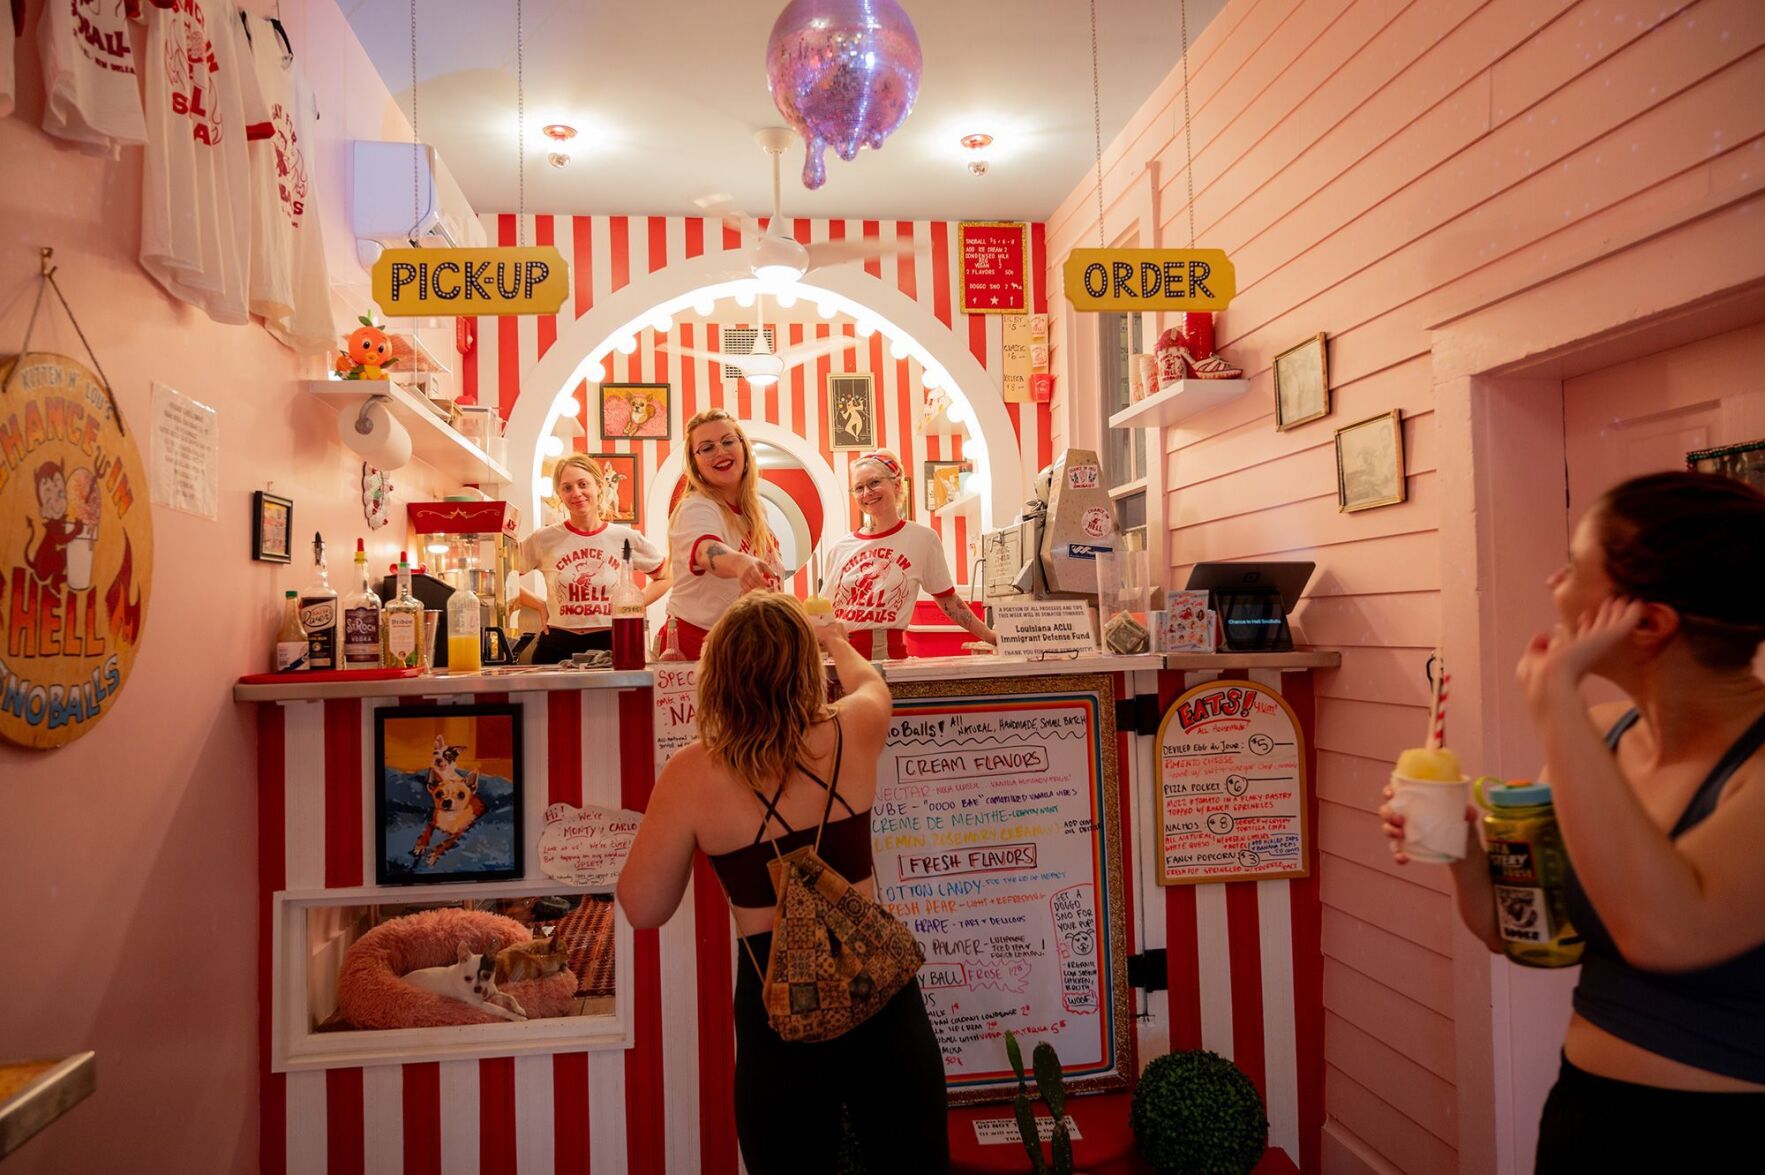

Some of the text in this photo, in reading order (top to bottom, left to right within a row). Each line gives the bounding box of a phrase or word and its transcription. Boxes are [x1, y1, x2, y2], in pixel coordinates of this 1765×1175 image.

[392, 261, 549, 301] PICK-UP
[1084, 261, 1215, 298] ORDER
[0, 396, 99, 491] HANCE
[1088, 521, 1102, 532] HELL
[555, 548, 620, 571] CHANCE IN
[843, 547, 911, 574] CHANCE IN
[568, 583, 609, 602] HELL
[846, 587, 886, 608] HELL
[8, 566, 105, 659] HELL
[1016, 623, 1072, 633] Louisiana ACLU
[1001, 632, 1090, 643] Immigrant Defense Fund
[0, 654, 120, 730] NOBALLS
[1177, 688, 1257, 730] EATS!
[1063, 715, 1086, 726] BATCH
[1163, 743, 1190, 755] DEVILED
[905, 751, 1042, 776] CREAM FLAVORS
[1164, 784, 1187, 795] PIZZA
[1191, 782, 1220, 792] POCKET
[545, 805, 565, 821] Hi!
[874, 802, 907, 816] UBE
[563, 823, 638, 838] MONTY CARLO
[872, 817, 920, 833] CREME
[926, 816, 943, 830] DE
[951, 810, 1008, 827] MENTHE
[1165, 822, 1199, 832] NACHOS
[910, 848, 1034, 873] FRESH FLAVORS
[1166, 855, 1194, 865] FANCY
[886, 879, 981, 901] OTTON CANDY
[887, 902, 920, 917] RESH
[1056, 909, 1093, 921] SNO FOR
[932, 938, 985, 956] PALMER
